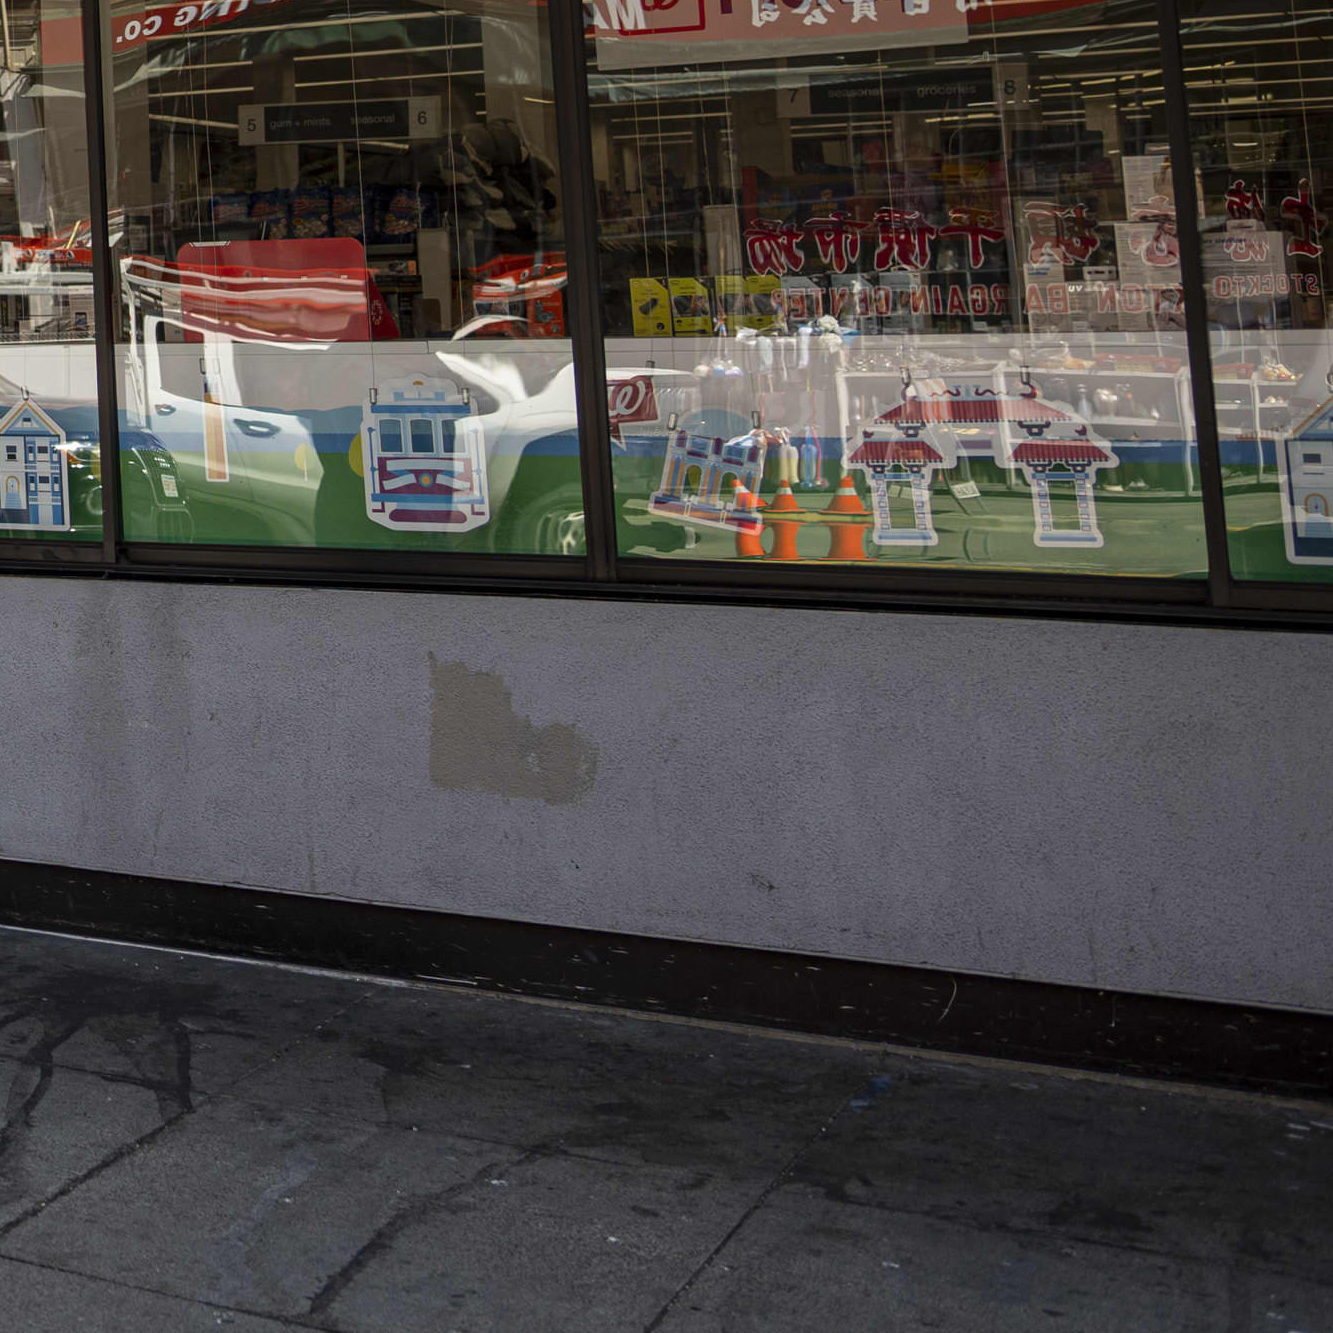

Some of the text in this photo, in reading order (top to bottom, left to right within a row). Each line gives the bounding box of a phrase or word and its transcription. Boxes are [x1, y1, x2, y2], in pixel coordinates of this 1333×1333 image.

[788, 88, 798, 103] 7
[916, 82, 977, 98] groceries
[1004, 78, 1015, 96] 8
[246, 118, 256, 132] 5
[269, 119, 292, 131] gum
[350, 113, 396, 127] seasonal
[417, 110, 427, 126] 6
